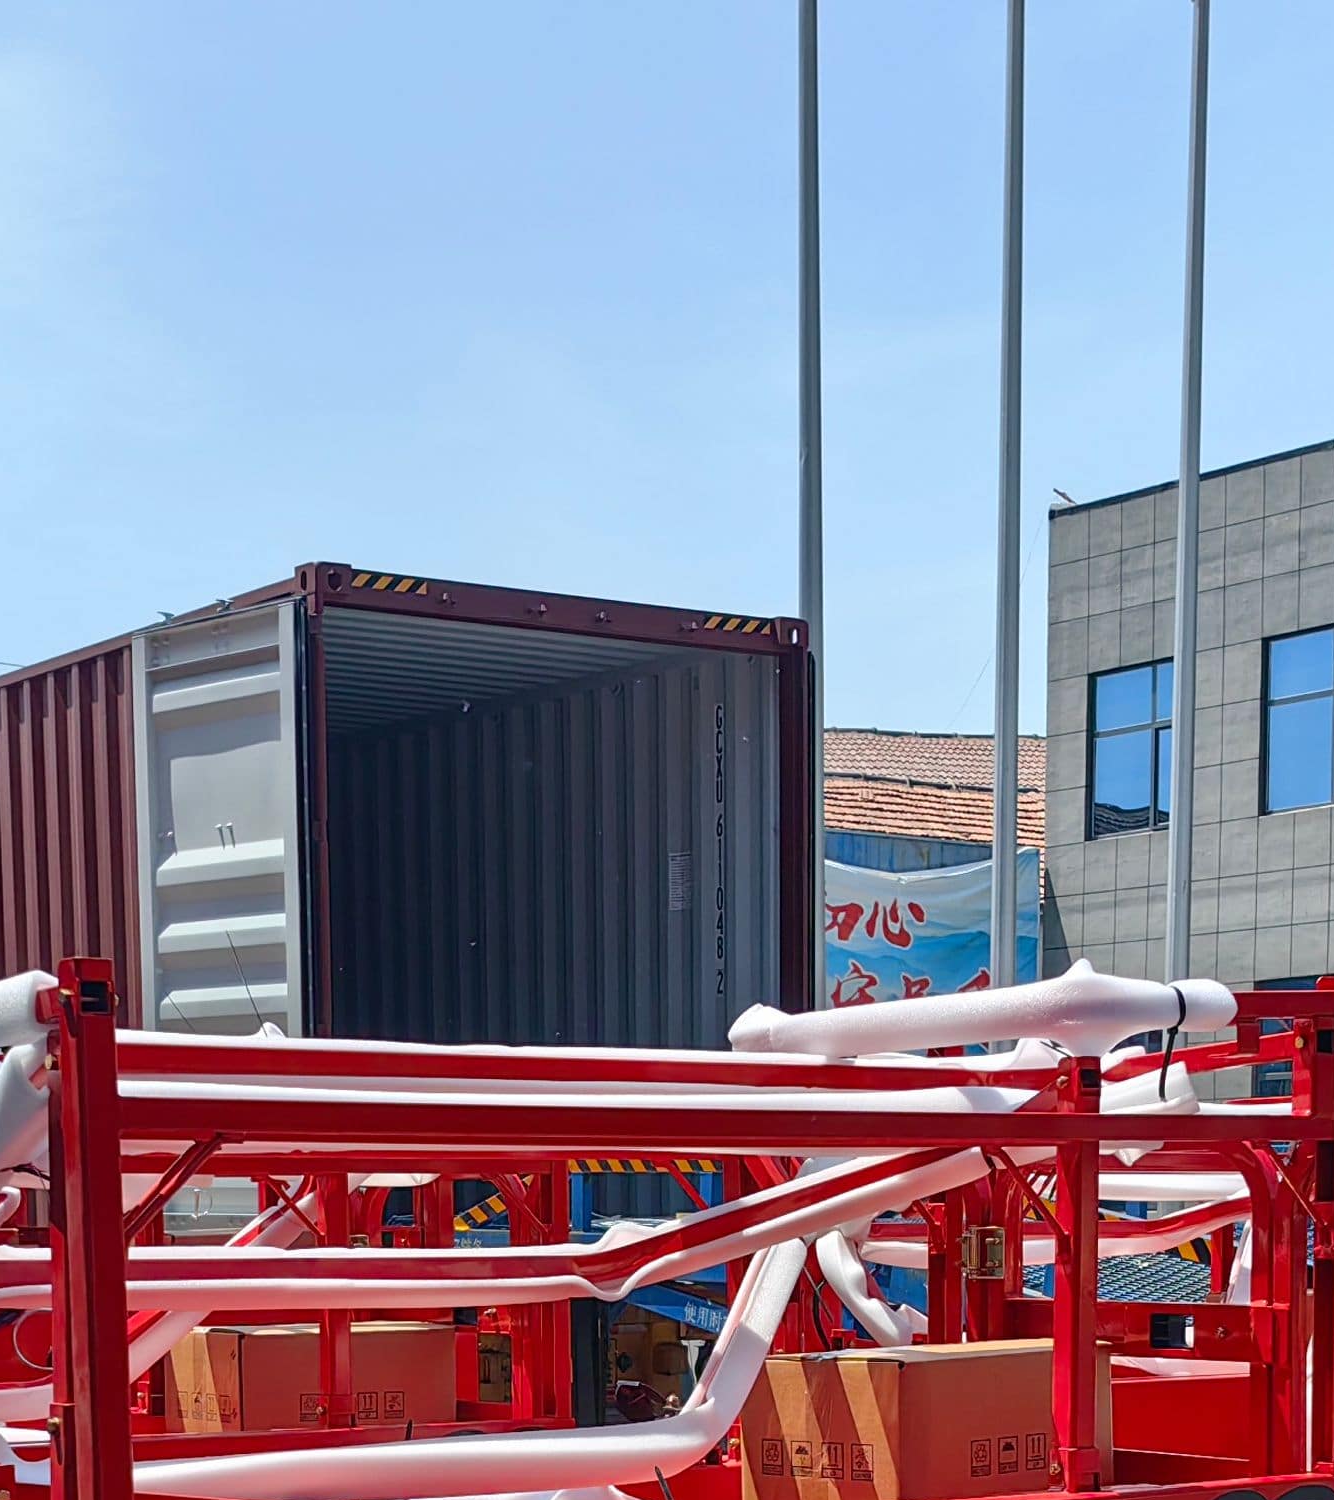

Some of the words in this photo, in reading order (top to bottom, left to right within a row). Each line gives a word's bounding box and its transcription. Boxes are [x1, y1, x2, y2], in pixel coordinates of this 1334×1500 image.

[715, 705, 724, 803] GCXU
[715, 813, 724, 959] 611048
[715, 969, 724, 994] 2
